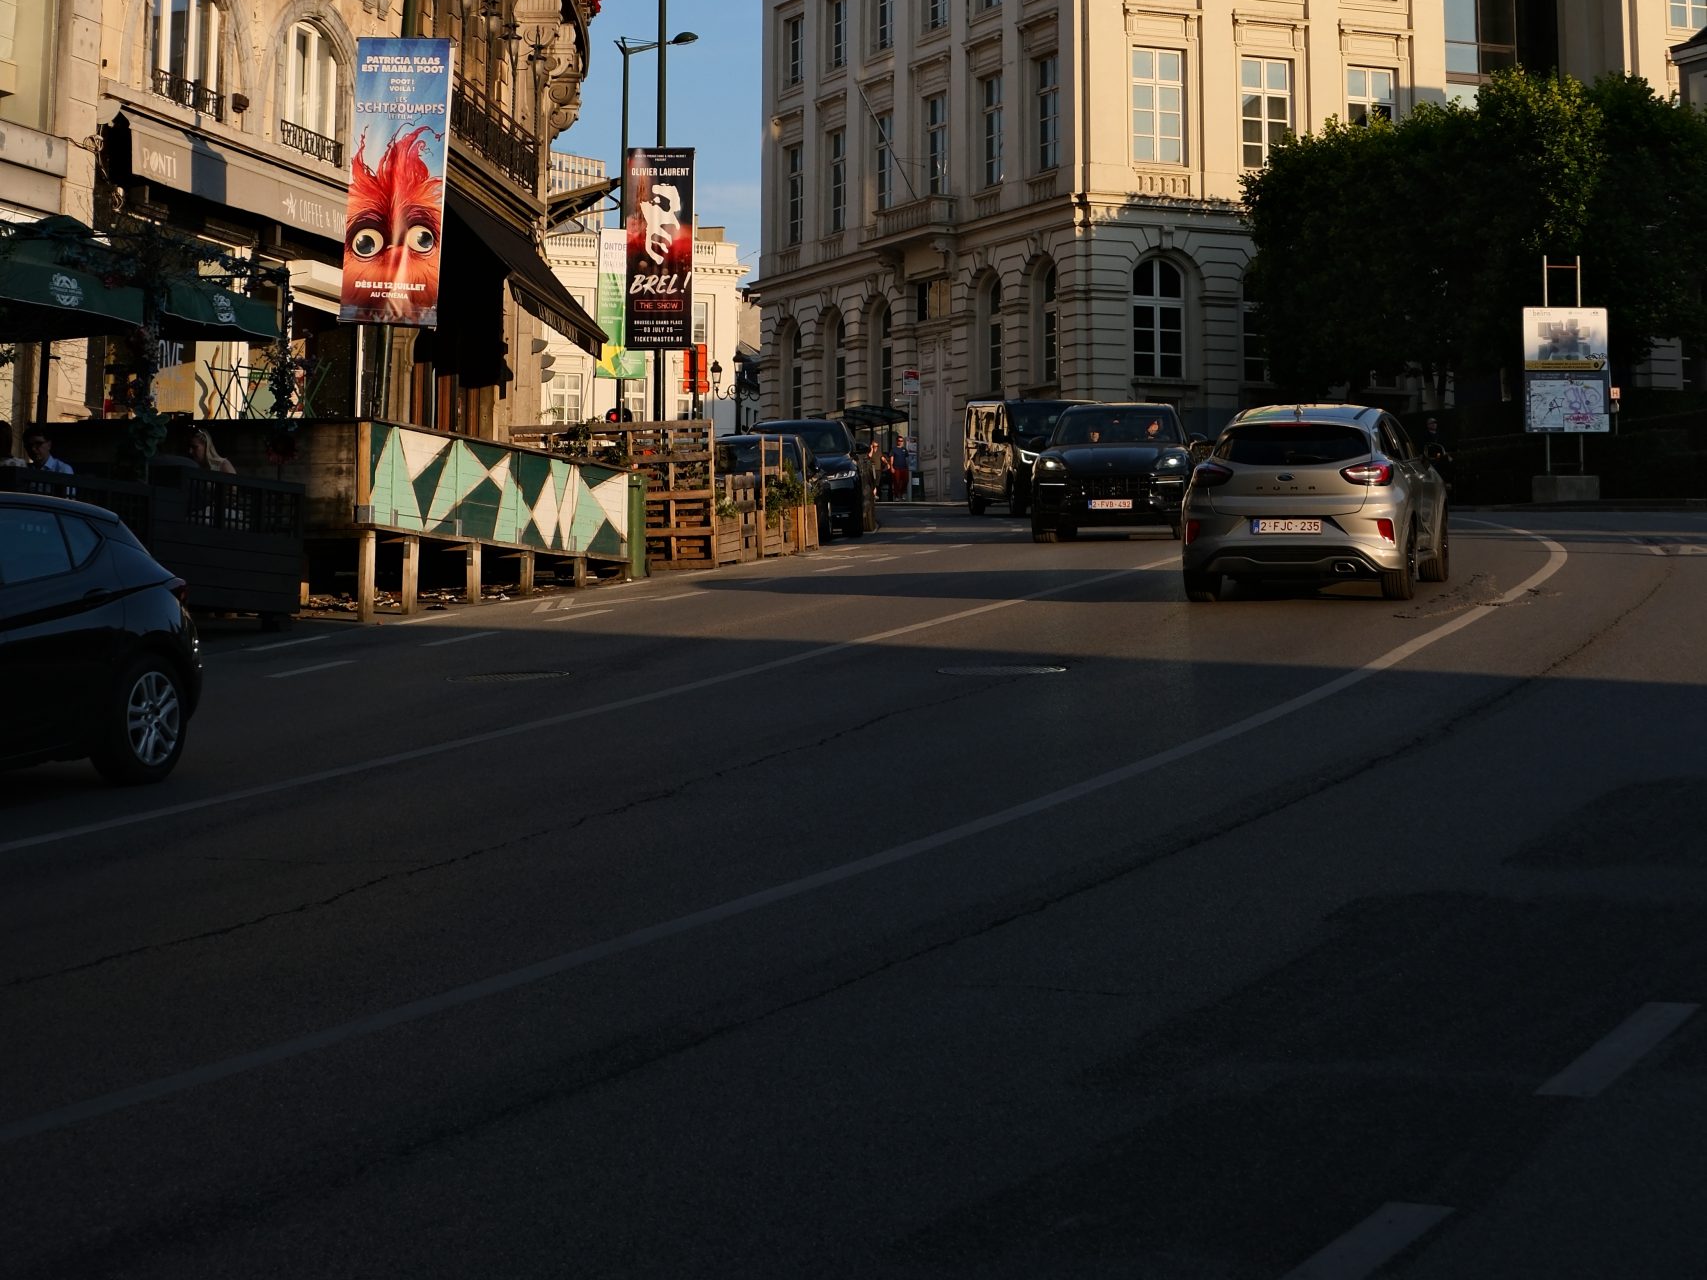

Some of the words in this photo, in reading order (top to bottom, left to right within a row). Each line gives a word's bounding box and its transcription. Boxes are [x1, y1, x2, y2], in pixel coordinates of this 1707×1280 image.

[366, 56, 411, 65] PATRICIA
[413, 56, 440, 65] KAAS
[361, 64, 379, 72] EST
[381, 64, 414, 73] MAMA
[416, 65, 445, 74] POOT
[356, 102, 445, 115] SCHTROUMPFS
[631, 167, 658, 176] OLIVIER
[659, 167, 690, 176] LAURENT
[299, 199, 324, 229] COFFEE
[332, 209, 348, 236] HOM
[604, 241, 627, 252] ONTDE
[354, 280, 373, 288] DÈS
[373, 281, 383, 289] LE
[393, 282, 426, 291] JUILLET
[639, 302, 654, 310] THE
[657, 302, 679, 310] SHOW
[157, 339, 185, 371] OVE
[1612, 389, 1618, 397] H
